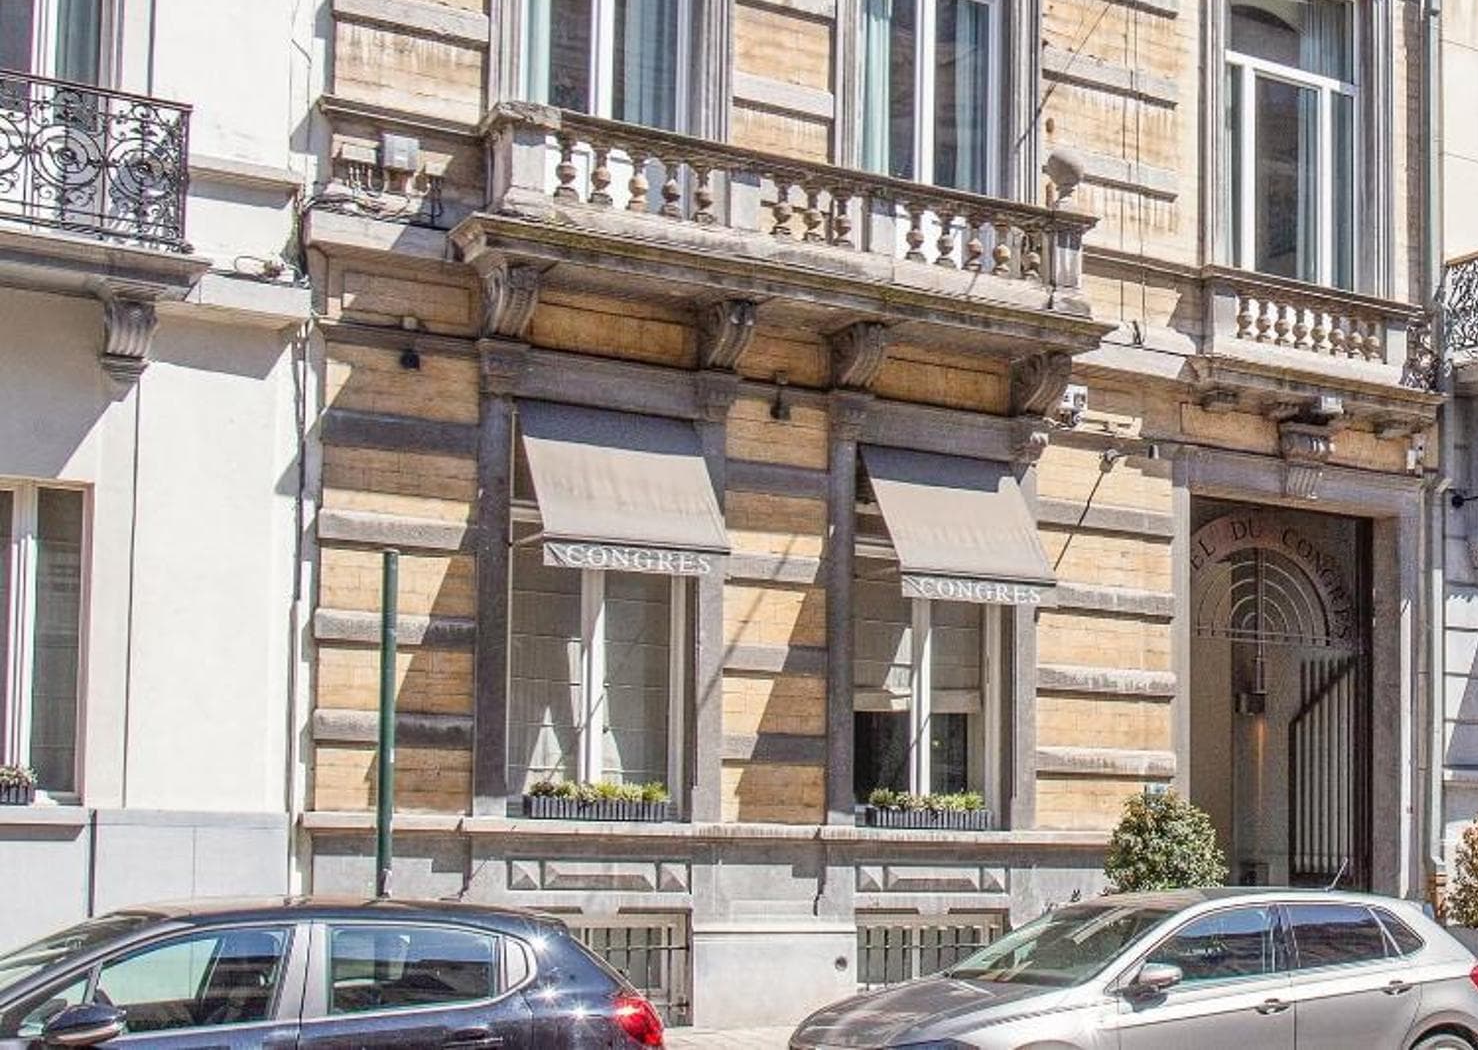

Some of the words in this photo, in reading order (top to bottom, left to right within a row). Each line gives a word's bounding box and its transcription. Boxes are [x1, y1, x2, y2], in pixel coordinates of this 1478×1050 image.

[1230, 517, 1263, 541] DU
[566, 544, 711, 574] CONGRES
[919, 577, 1041, 604] CONGRES
